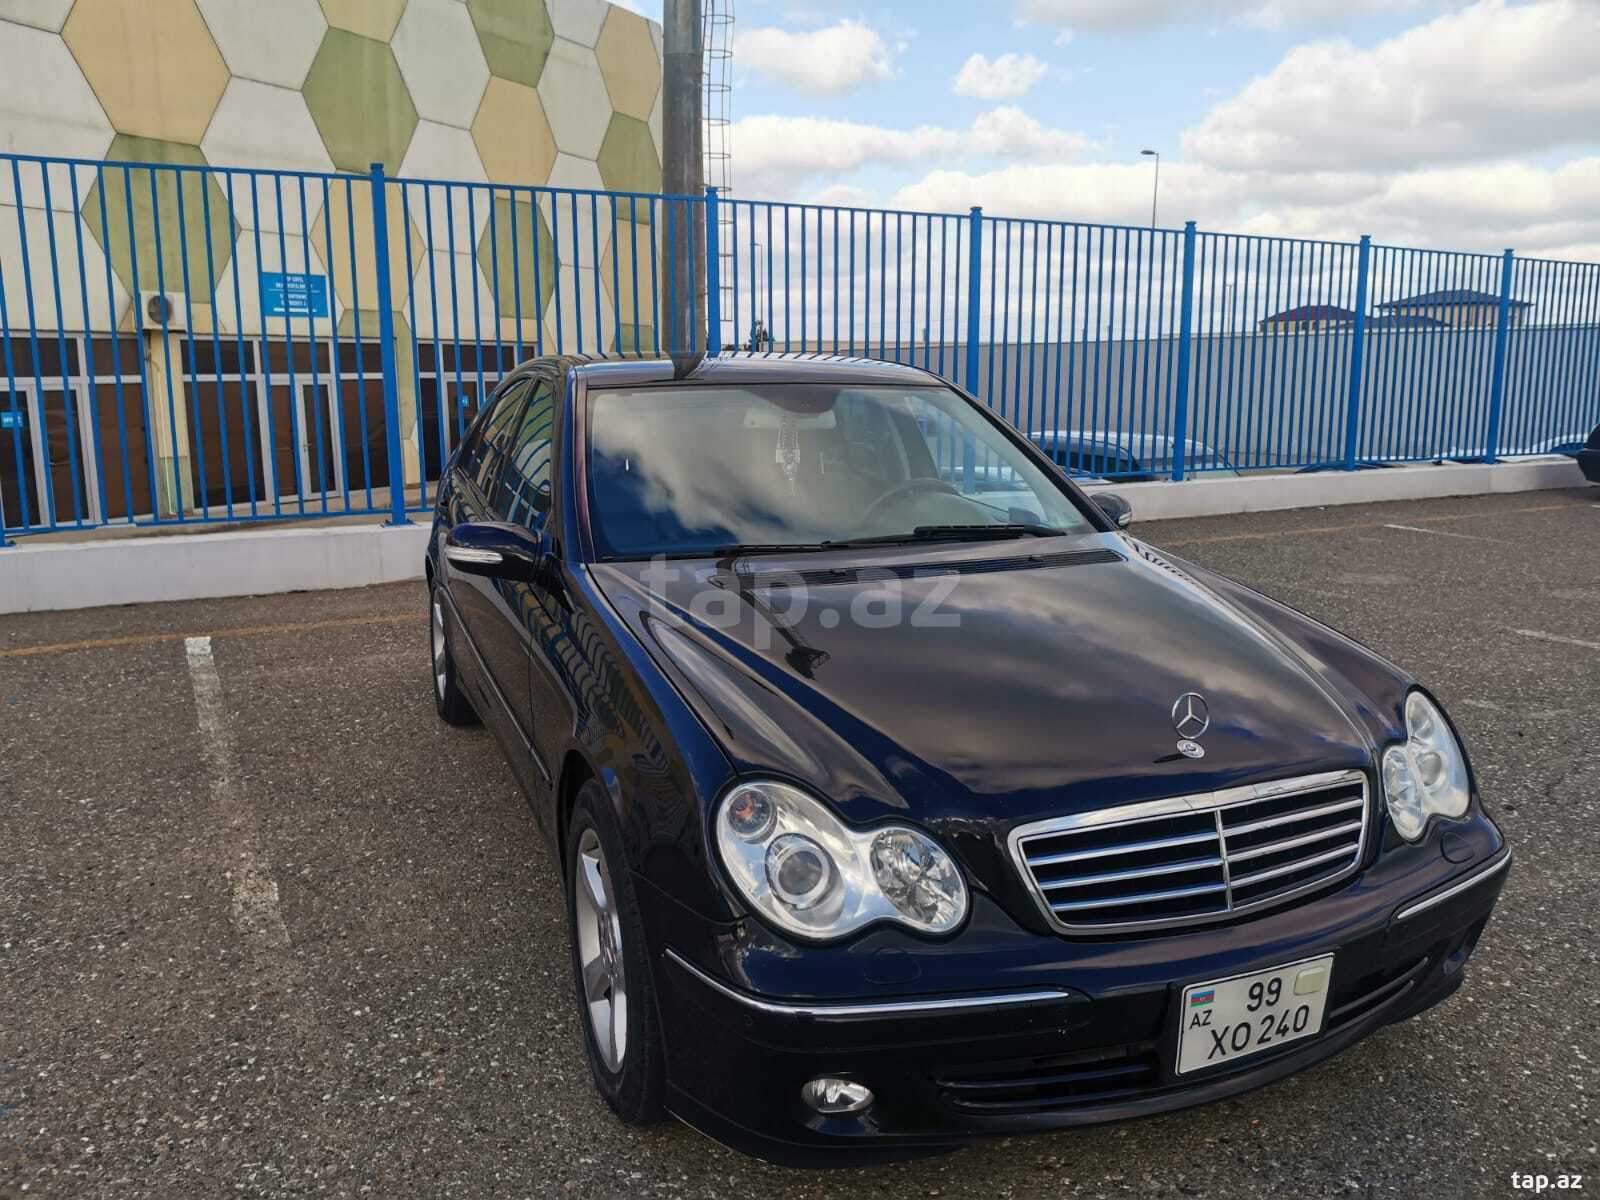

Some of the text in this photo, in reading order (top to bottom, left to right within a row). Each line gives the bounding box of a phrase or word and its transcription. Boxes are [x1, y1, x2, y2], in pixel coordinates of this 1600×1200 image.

[1247, 977, 1282, 1012] 99
[1189, 1009, 1212, 1029] AZ
[1207, 1005, 1310, 1059] XO 240
